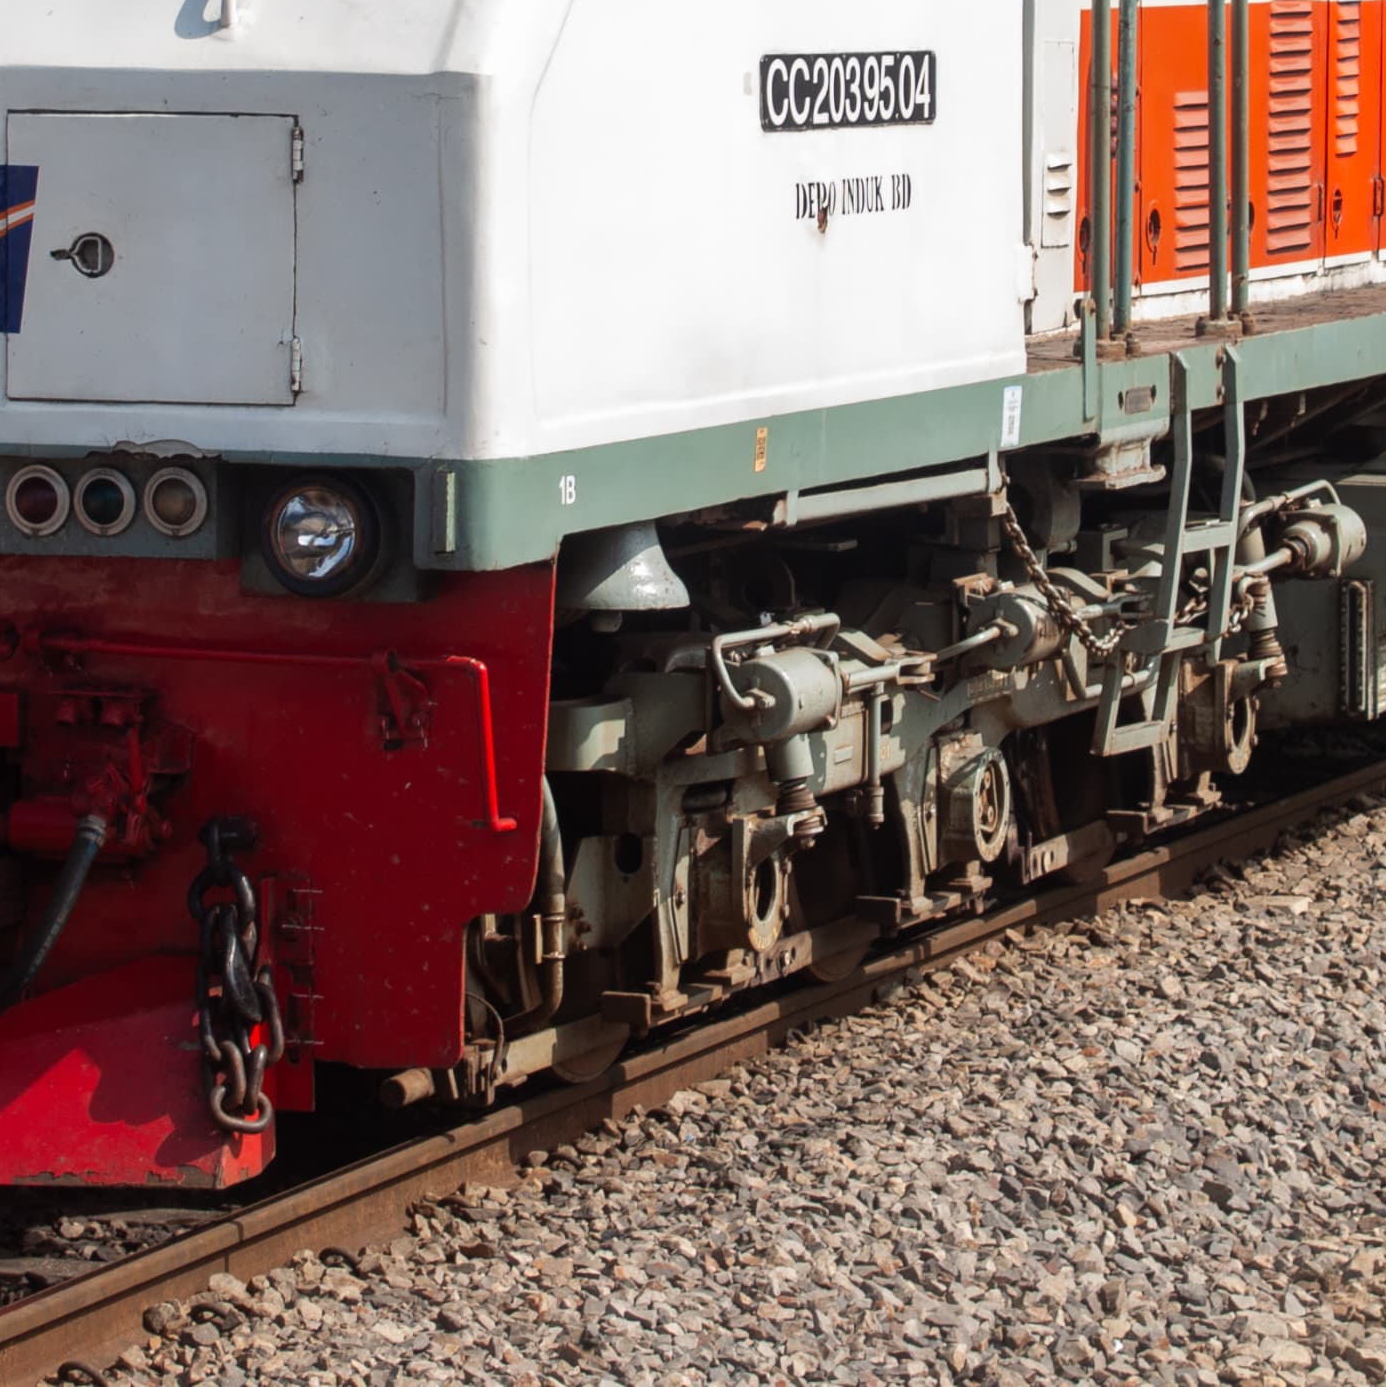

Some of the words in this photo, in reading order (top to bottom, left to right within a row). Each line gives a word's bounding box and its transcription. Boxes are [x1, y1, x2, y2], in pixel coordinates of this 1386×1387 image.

[796, 181, 836, 220] DEPO
[842, 175, 885, 215] INDUK
[891, 174, 912, 211] BD
[558, 475, 576, 505] 1B
